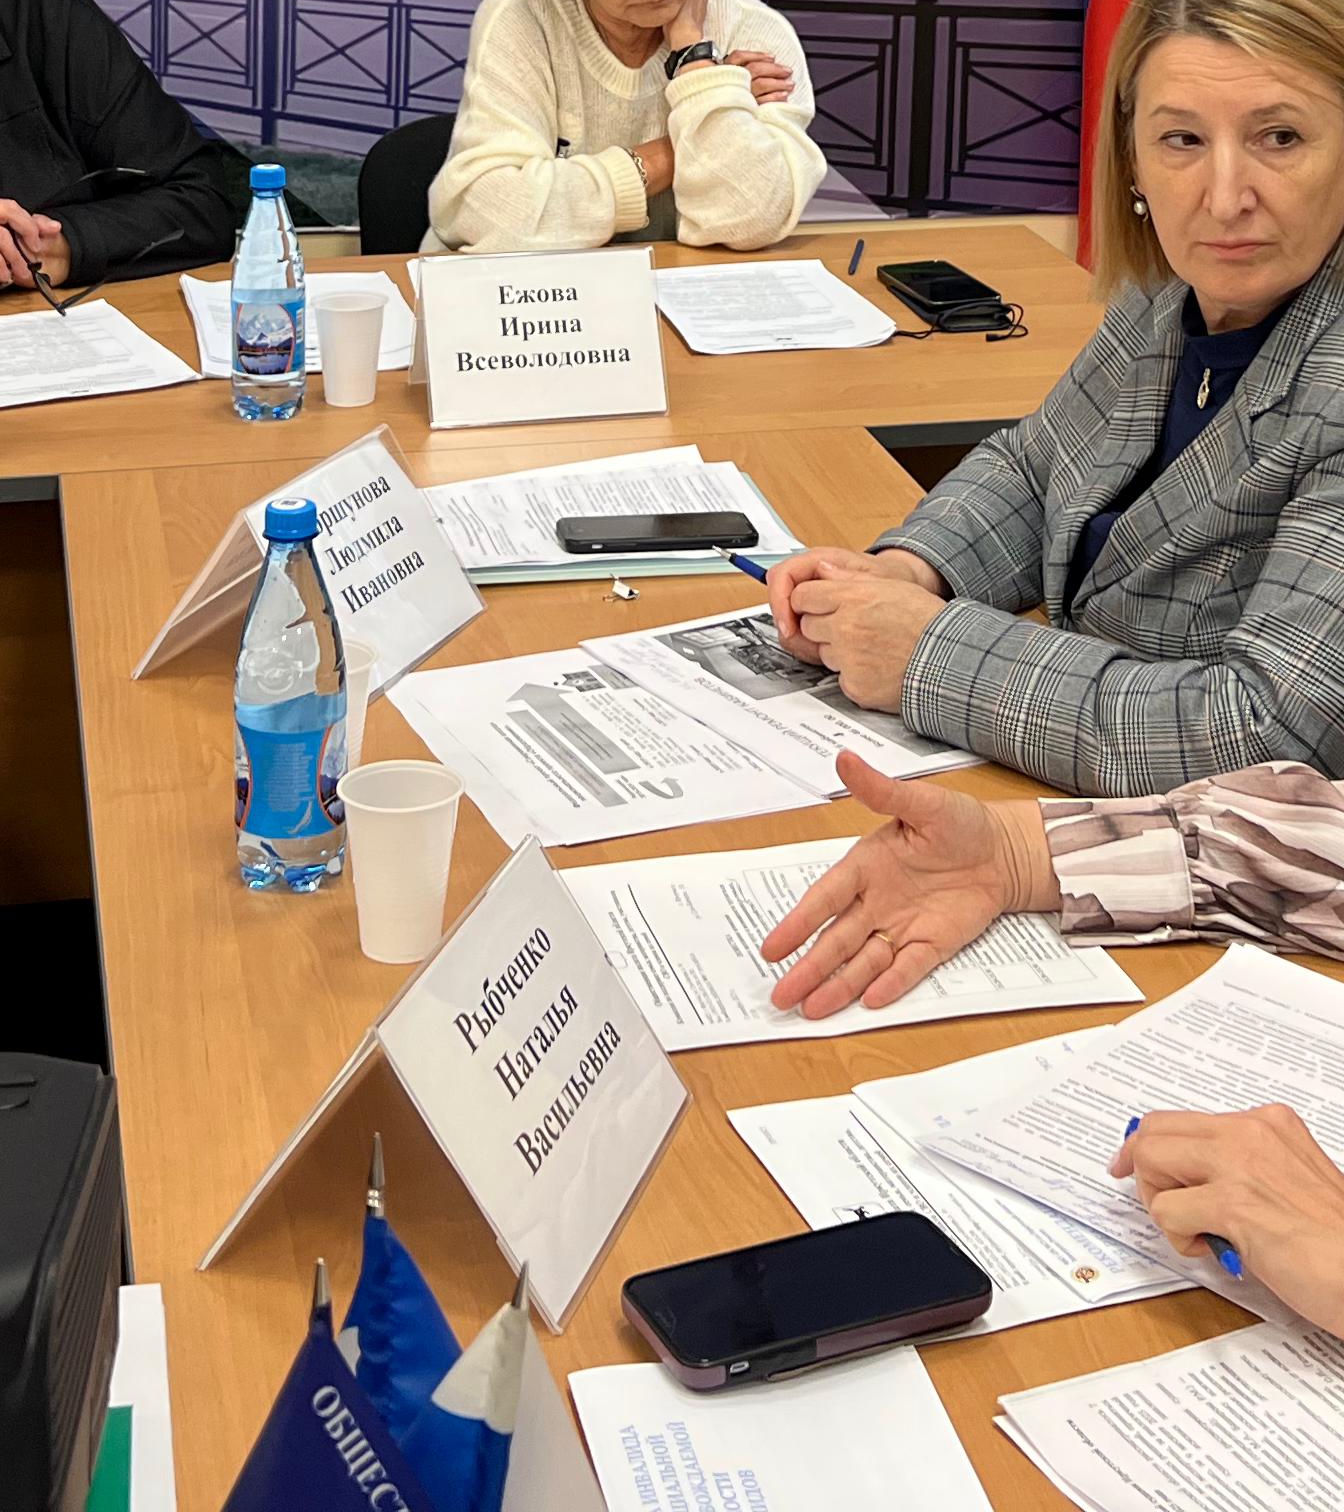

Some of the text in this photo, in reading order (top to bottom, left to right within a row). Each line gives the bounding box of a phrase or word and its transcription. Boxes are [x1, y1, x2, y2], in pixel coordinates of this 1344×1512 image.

[499, 285, 578, 305] Ежова
[456, 347, 631, 372] Всеволодовна
[500, 317, 582, 341] Ирина
[325, 515, 404, 576] Людмила
[341, 551, 425, 614] Ивановна
[453, 927, 551, 1055] Рыбченко
[493, 984, 578, 1101] Наталья
[513, 1021, 621, 1176] Васильевна
